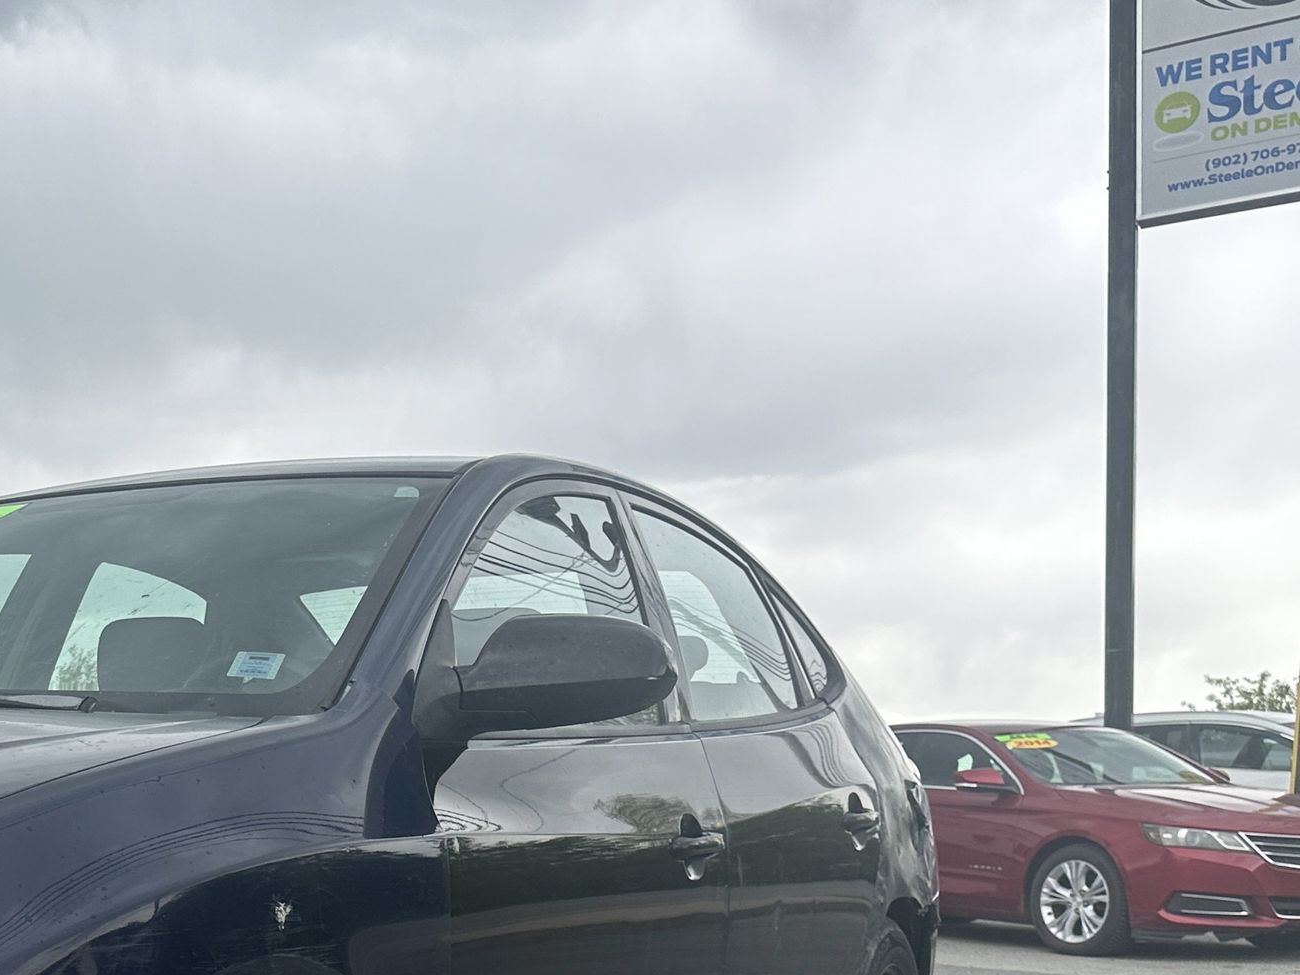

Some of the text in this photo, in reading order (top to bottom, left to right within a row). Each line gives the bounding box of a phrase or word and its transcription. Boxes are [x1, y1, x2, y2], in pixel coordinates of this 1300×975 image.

[1156, 37, 1294, 87] WE RENT
[1207, 74, 1300, 123] Ste
[1211, 121, 1248, 141] ON
[1205, 152, 1248, 172] (902)
